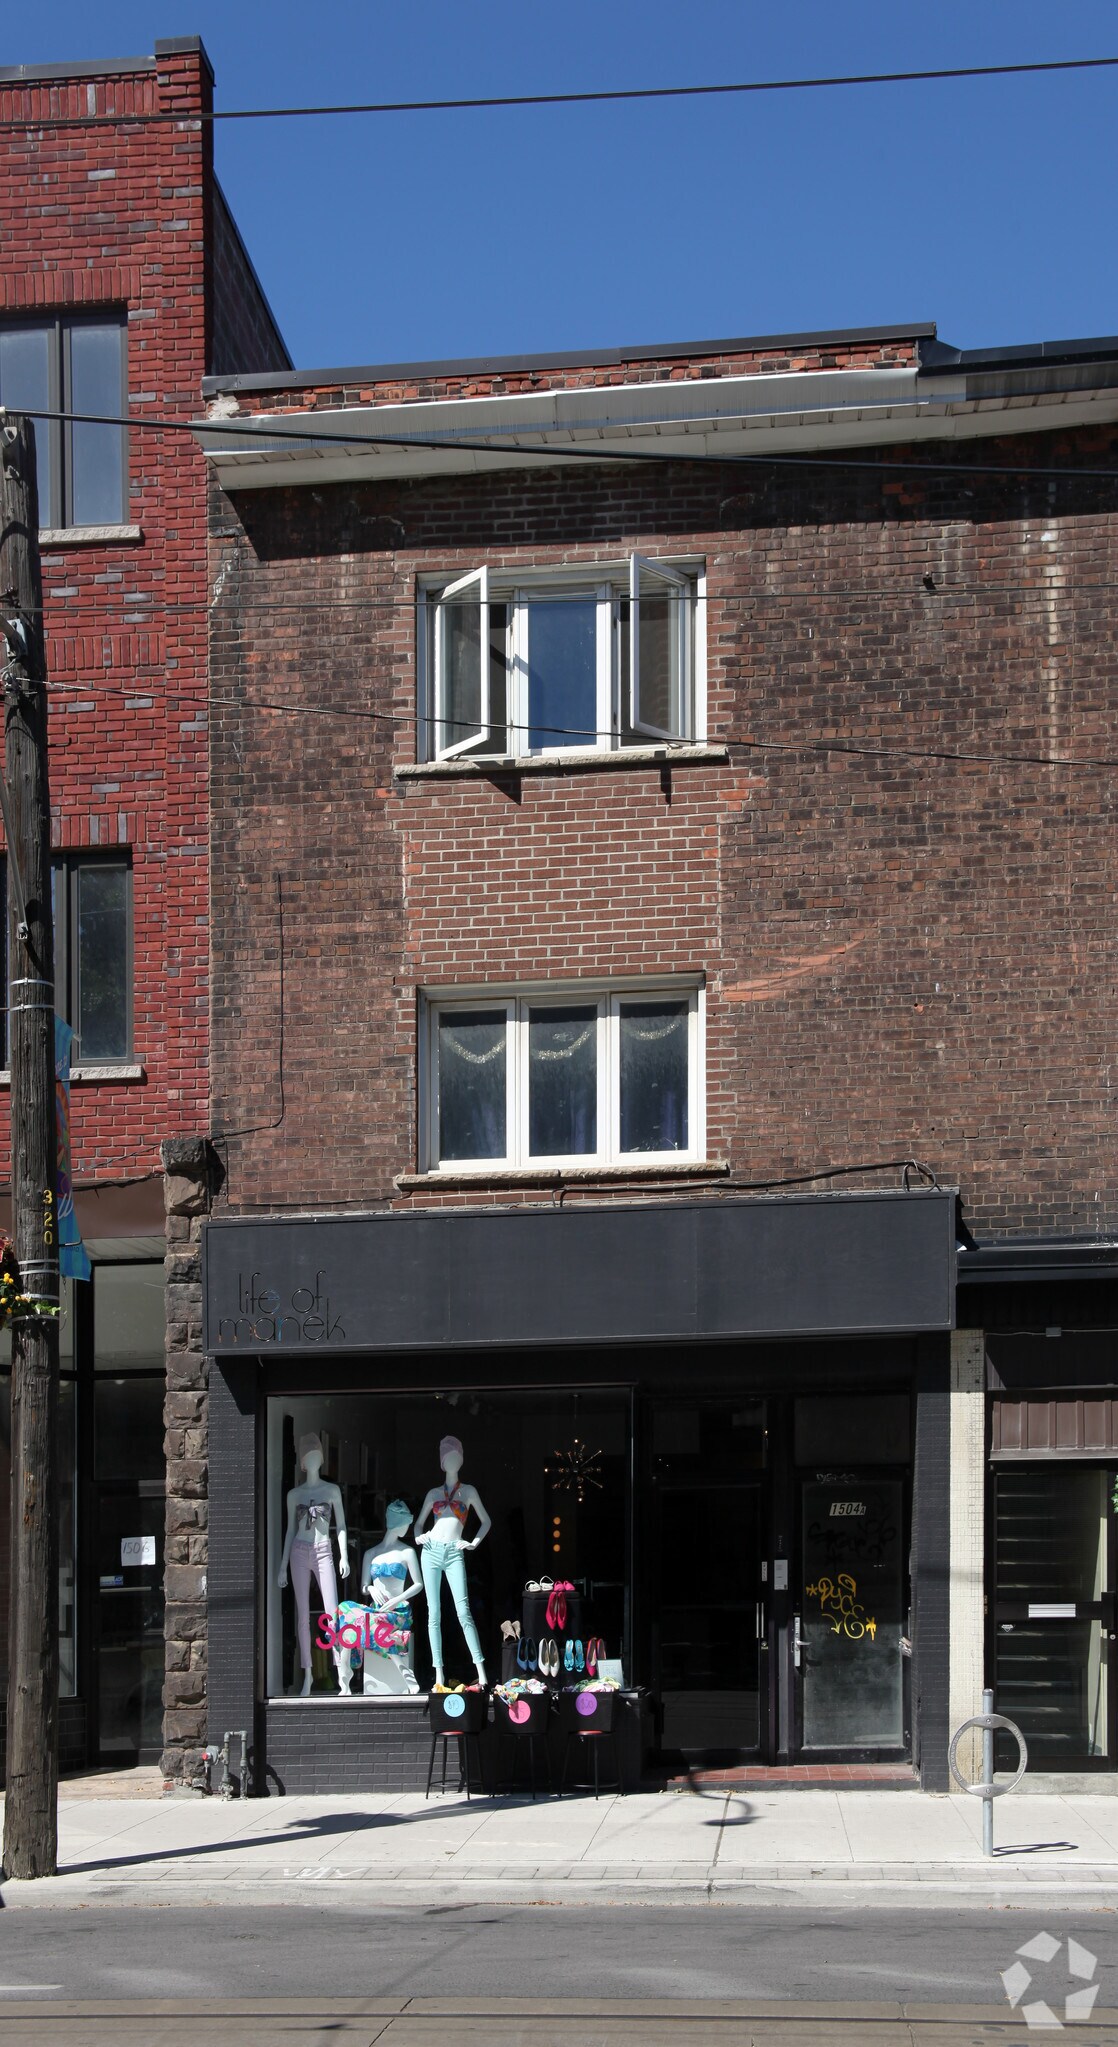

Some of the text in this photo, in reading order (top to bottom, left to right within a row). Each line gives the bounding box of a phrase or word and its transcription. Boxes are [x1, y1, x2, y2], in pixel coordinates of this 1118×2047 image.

[42, 1189, 53, 1245] 320
[239, 1270, 327, 1315] life of
[218, 1298, 346, 1343] manek
[315, 1612, 396, 1650] Sale
